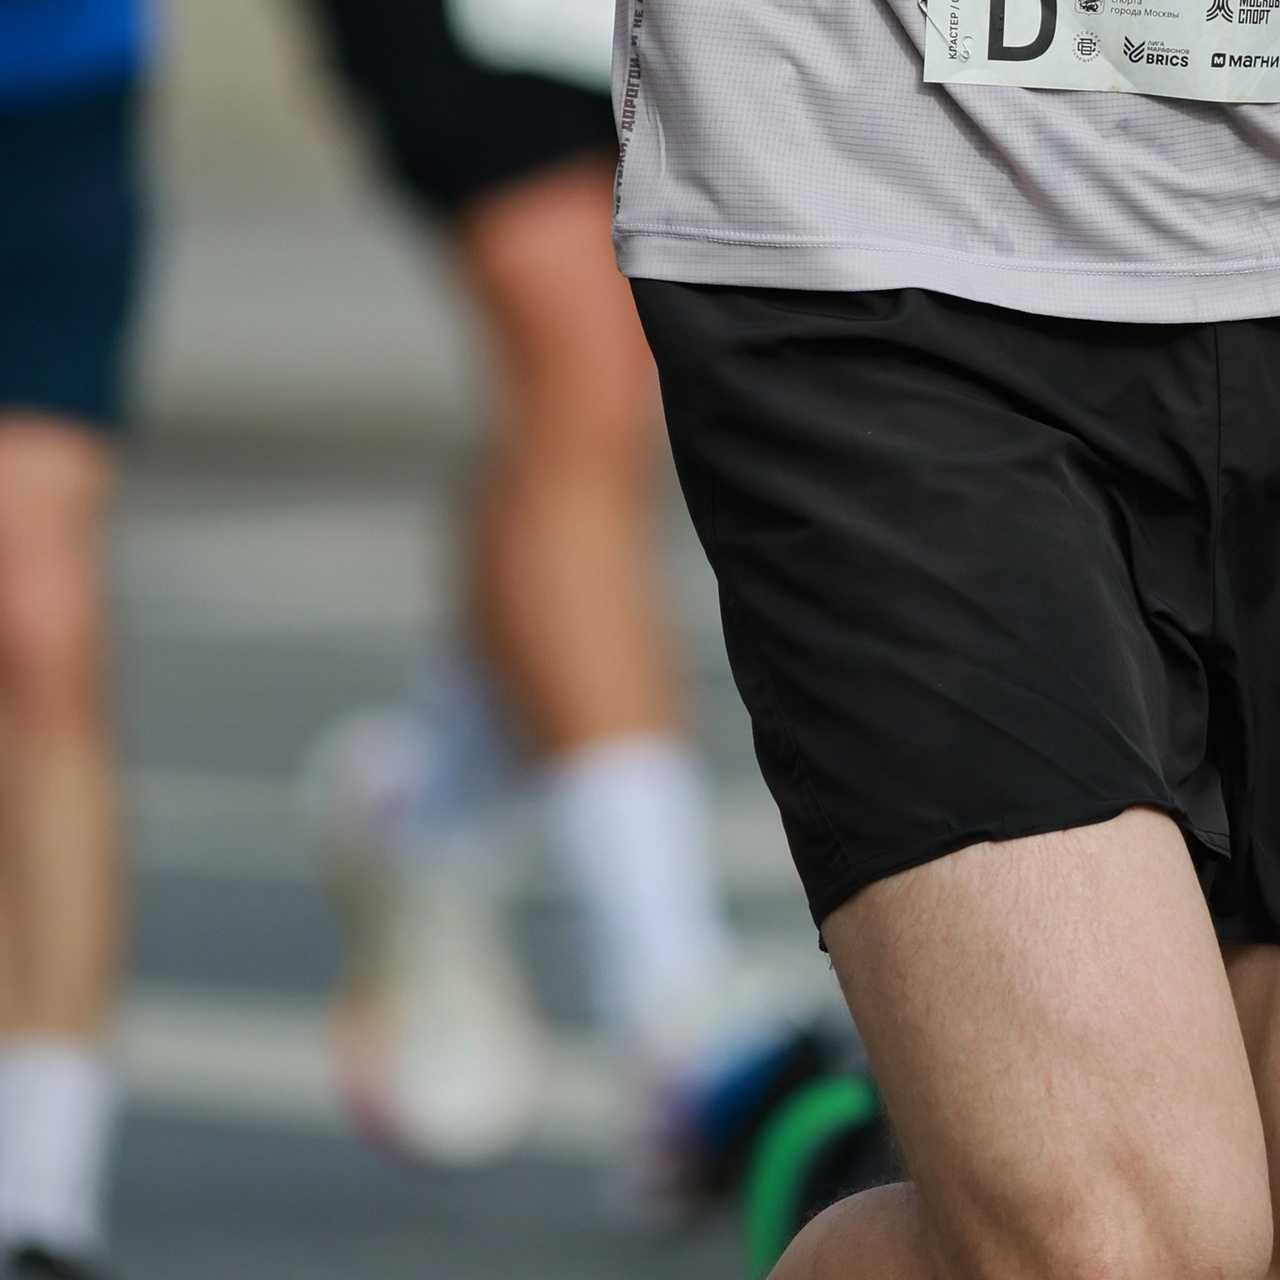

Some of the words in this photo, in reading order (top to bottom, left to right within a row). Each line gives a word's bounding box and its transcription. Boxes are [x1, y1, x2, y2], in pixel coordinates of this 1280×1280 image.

[1110, 6, 1142, 17] города
[1144, 8, 1180, 18] Москвы
[1238, 8, 1271, 25] СПОРТ
[948, 12, 960, 60] КЛАСТЕР
[1146, 53, 1189, 67] BRICS
